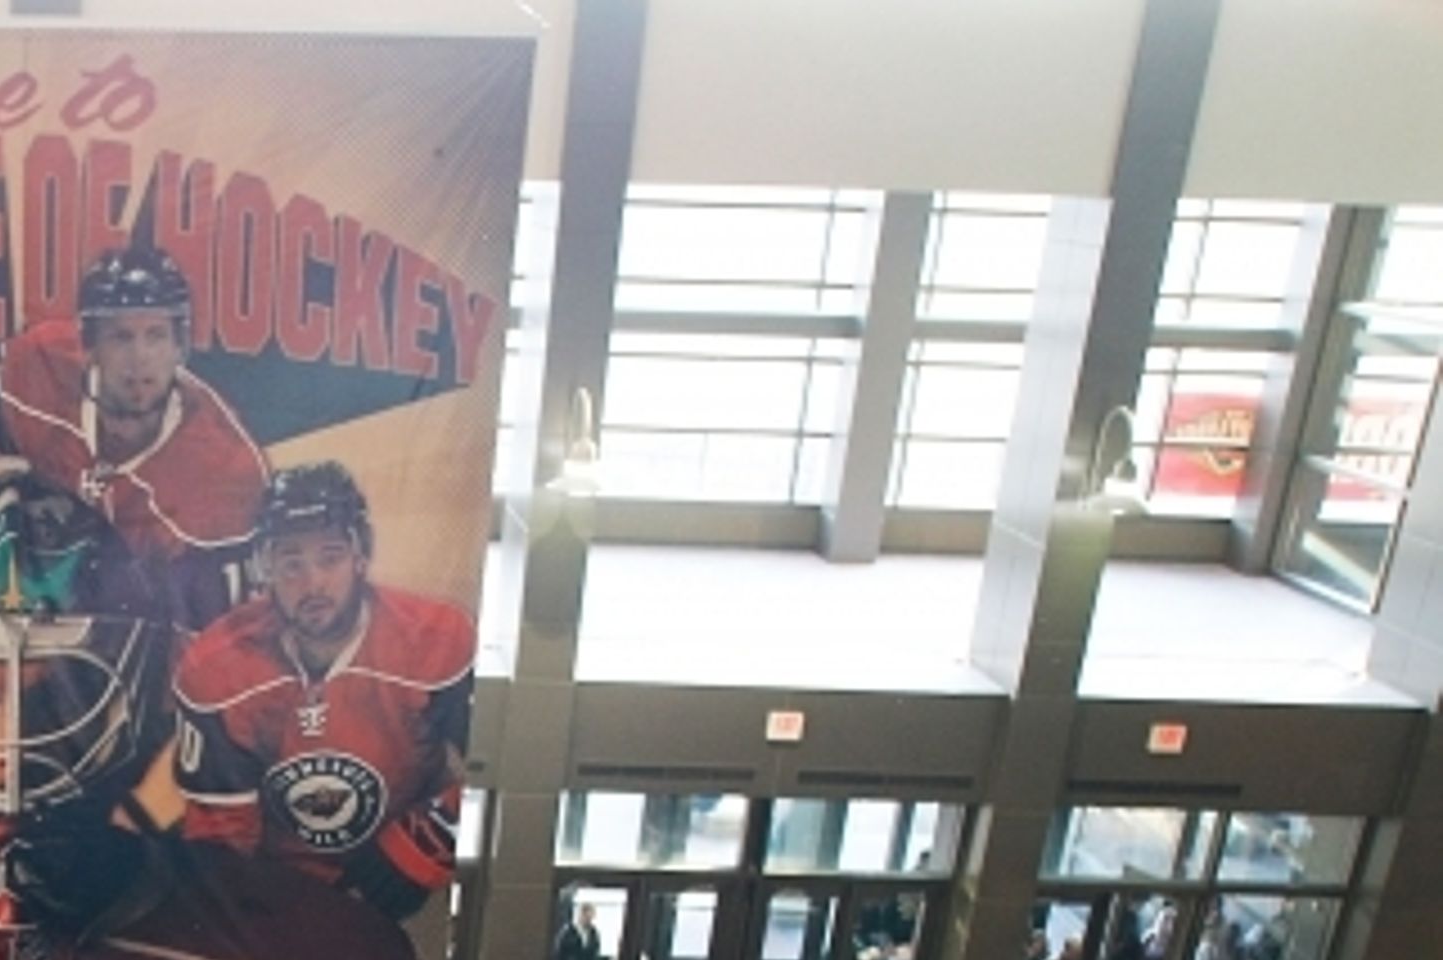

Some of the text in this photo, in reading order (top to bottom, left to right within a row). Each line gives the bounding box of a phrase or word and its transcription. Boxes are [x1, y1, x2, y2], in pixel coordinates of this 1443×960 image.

[61, 56, 157, 131] to
[24, 134, 132, 322] OF
[154, 150, 495, 384] HOCKEY
